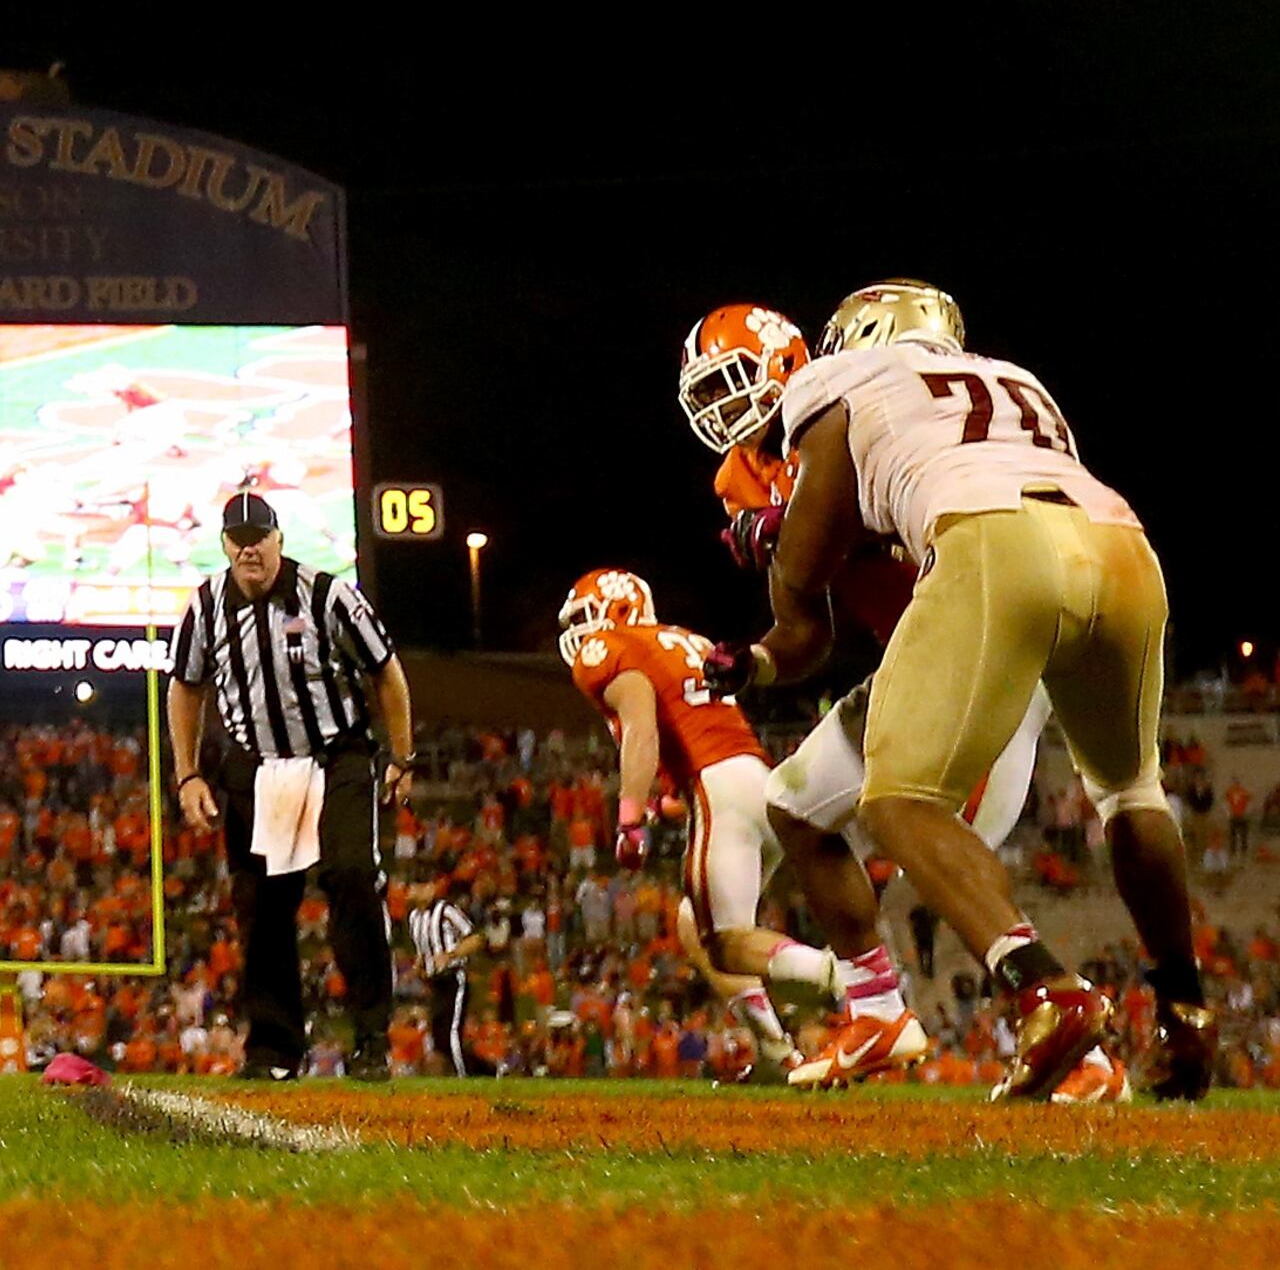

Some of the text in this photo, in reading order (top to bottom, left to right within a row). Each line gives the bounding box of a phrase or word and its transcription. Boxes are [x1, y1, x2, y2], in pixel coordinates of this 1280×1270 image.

[6, 115, 326, 242] STADIUM
[88, 275, 198, 311] FIELD
[380, 489, 435, 535] 05
[3, 639, 91, 670] RIGHT
